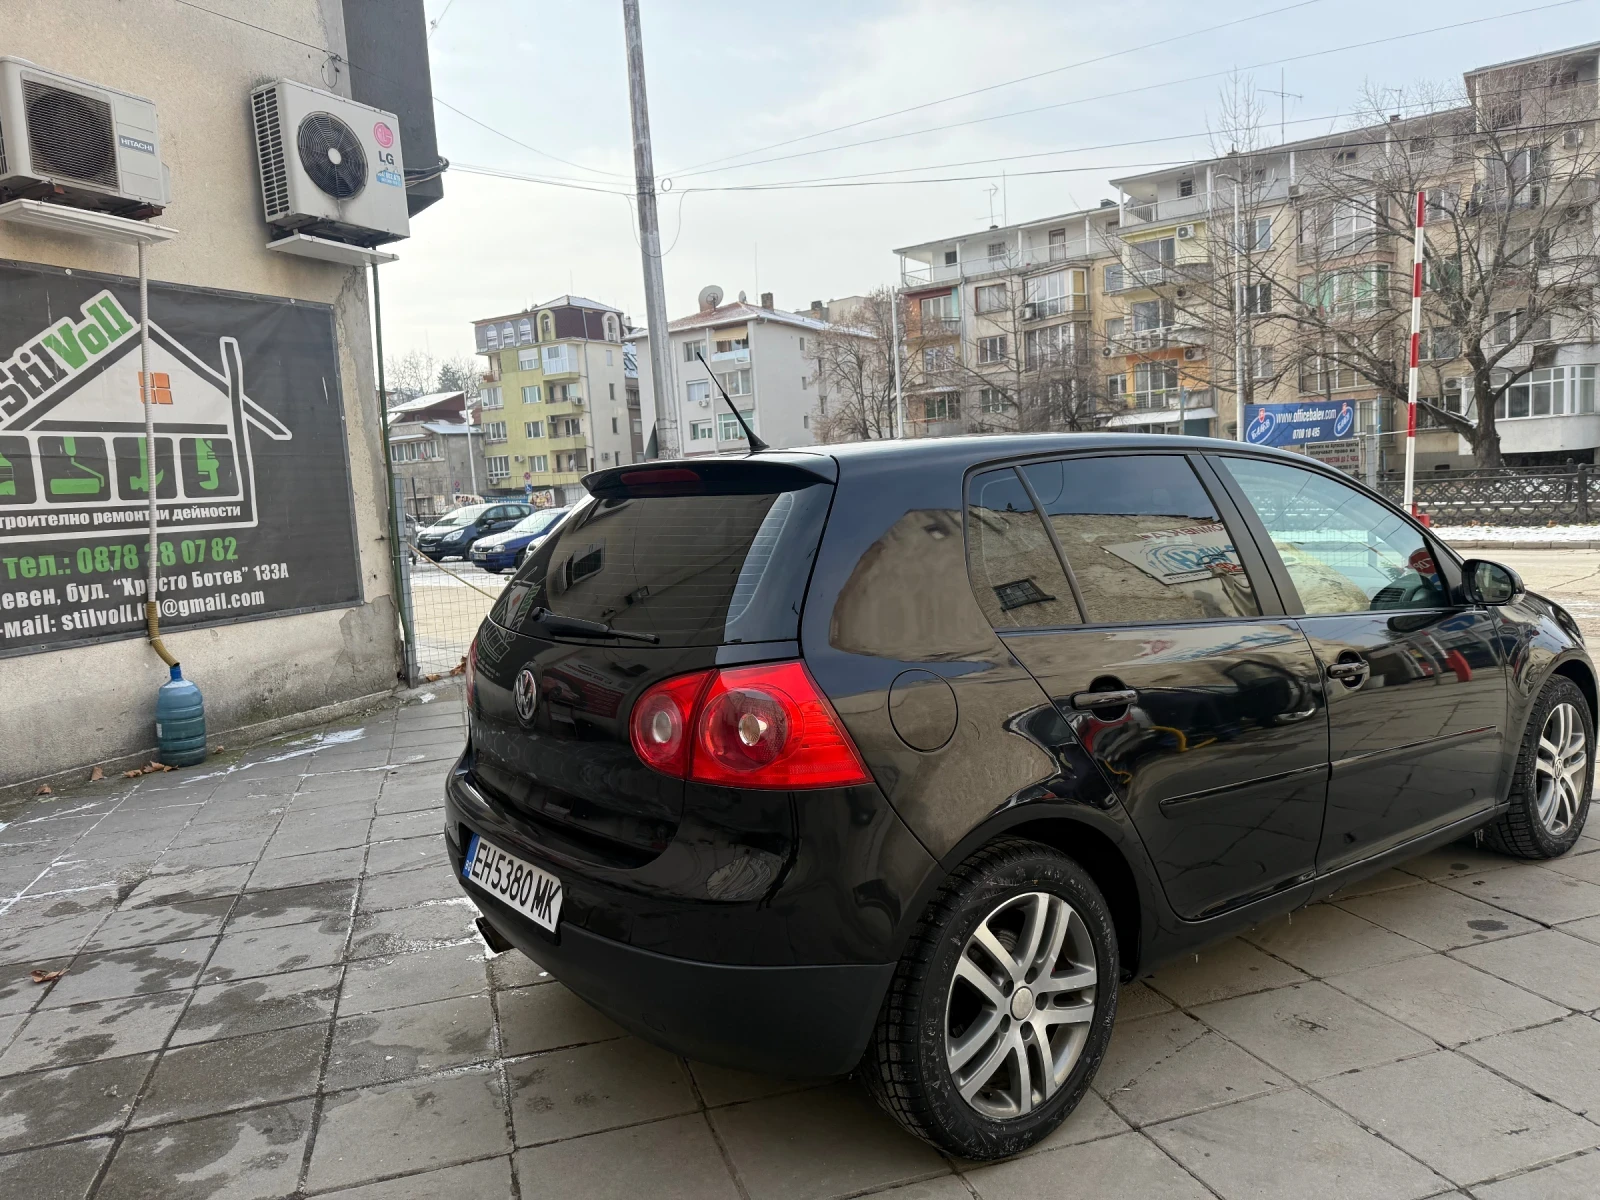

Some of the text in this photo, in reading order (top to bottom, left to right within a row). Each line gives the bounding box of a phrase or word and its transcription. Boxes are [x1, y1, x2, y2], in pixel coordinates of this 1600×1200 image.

[120, 137, 153, 152] HITACHI
[378, 150, 394, 165] LG
[1275, 408, 1337, 424] www.officebalev.com
[172, 505, 241, 521] дейности
[3, 554, 71, 580] тел.:
[77, 544, 139, 574] 0878
[181, 538, 207, 564] 07
[211, 536, 239, 561] 82
[0, 588, 61, 610] евен,
[66, 583, 110, 602] бул.
